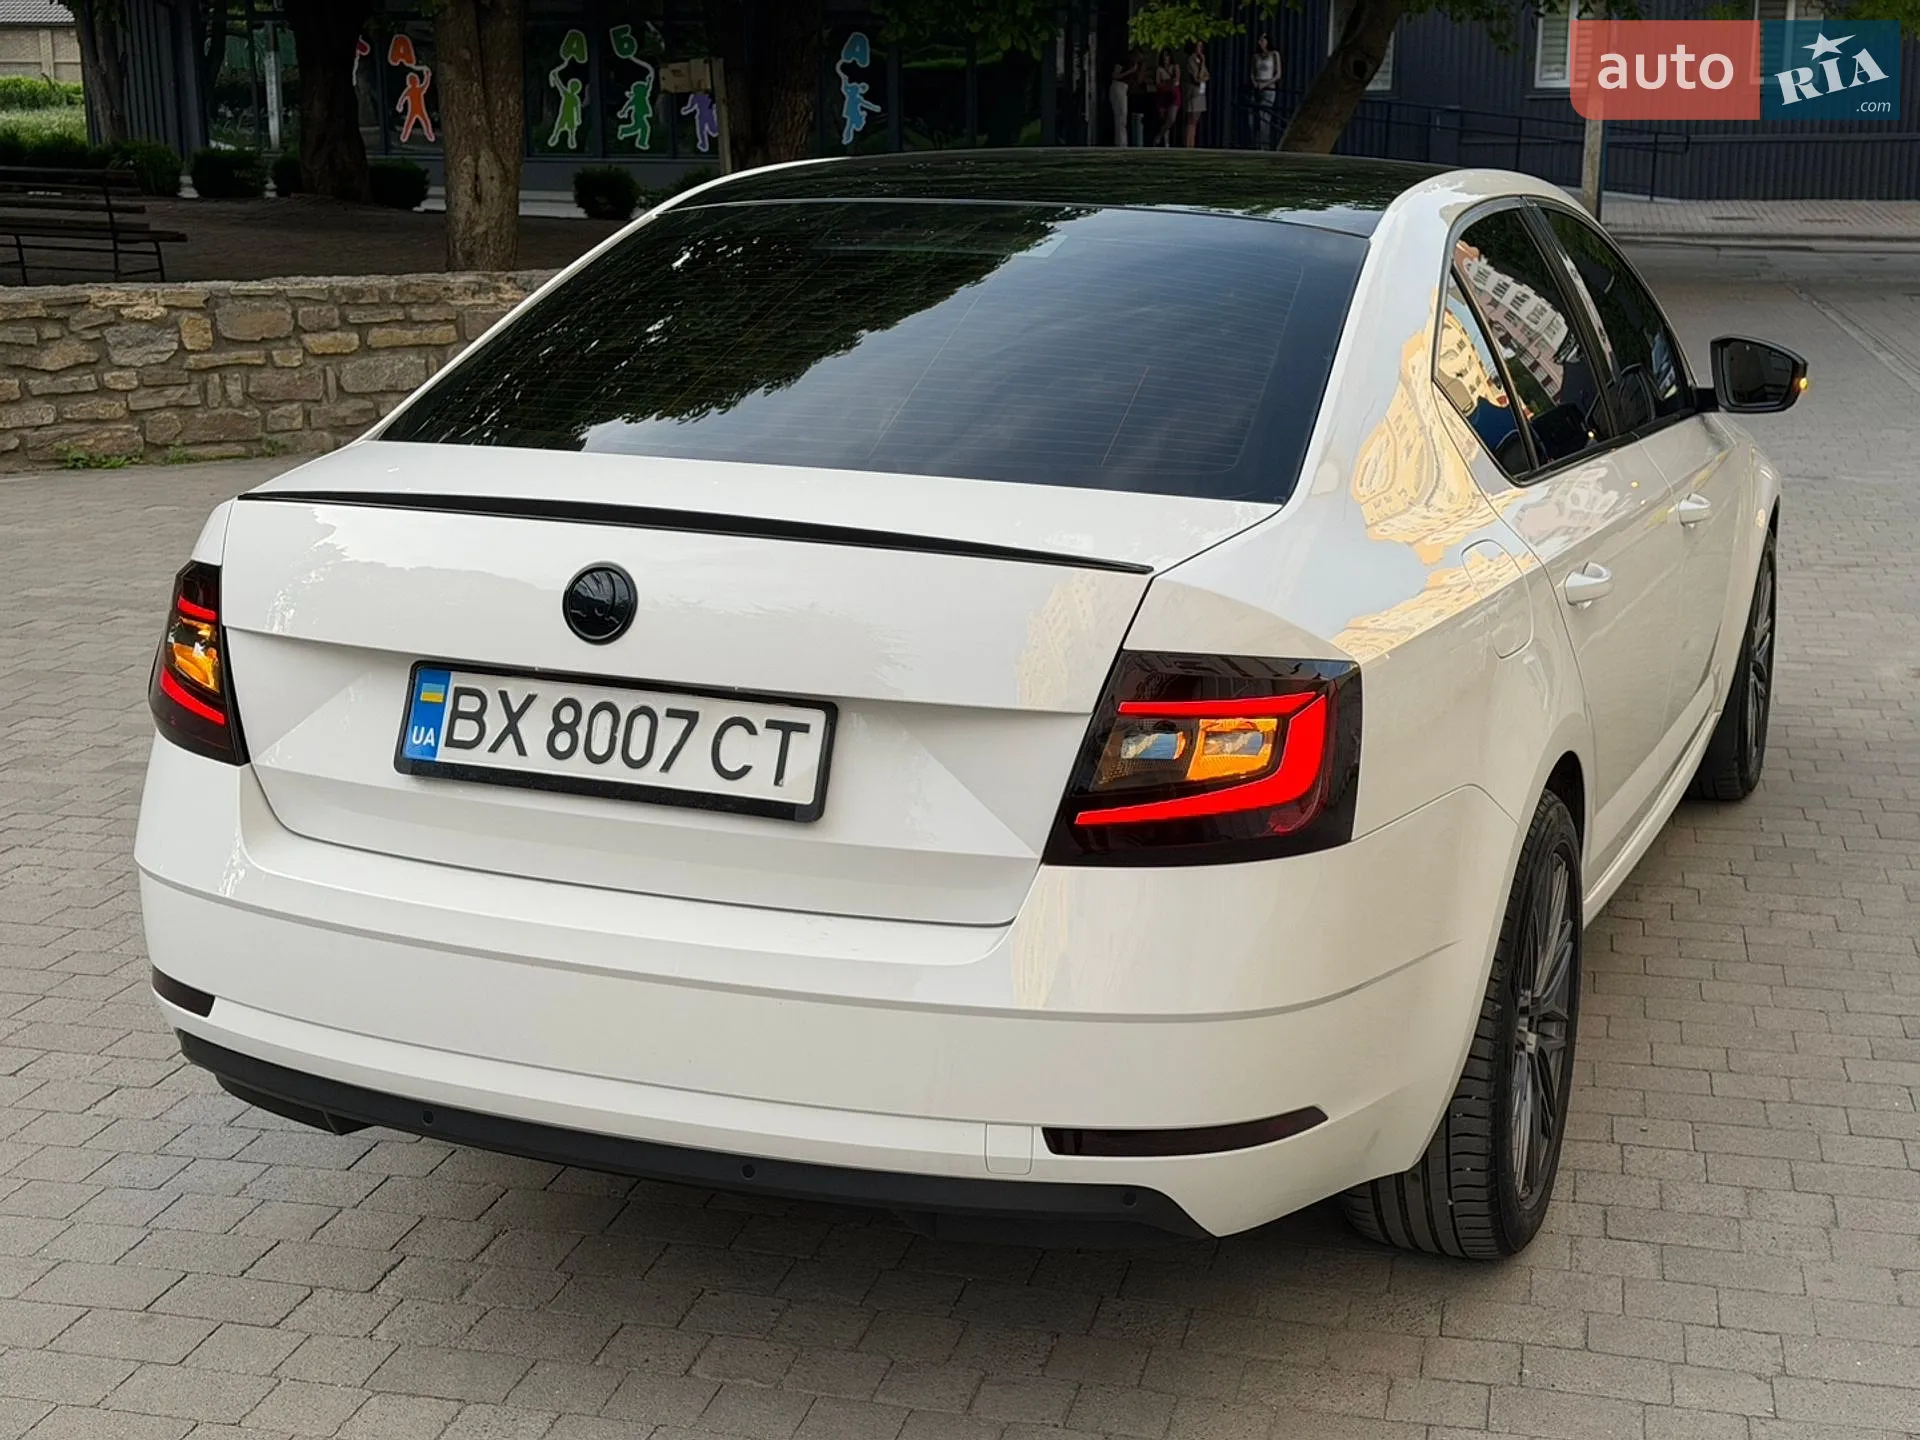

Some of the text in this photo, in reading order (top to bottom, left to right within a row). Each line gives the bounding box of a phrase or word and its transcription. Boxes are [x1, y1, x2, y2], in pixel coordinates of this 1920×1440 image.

[411, 725, 436, 748] UA
[444, 686, 811, 787] BX 8007 CT
